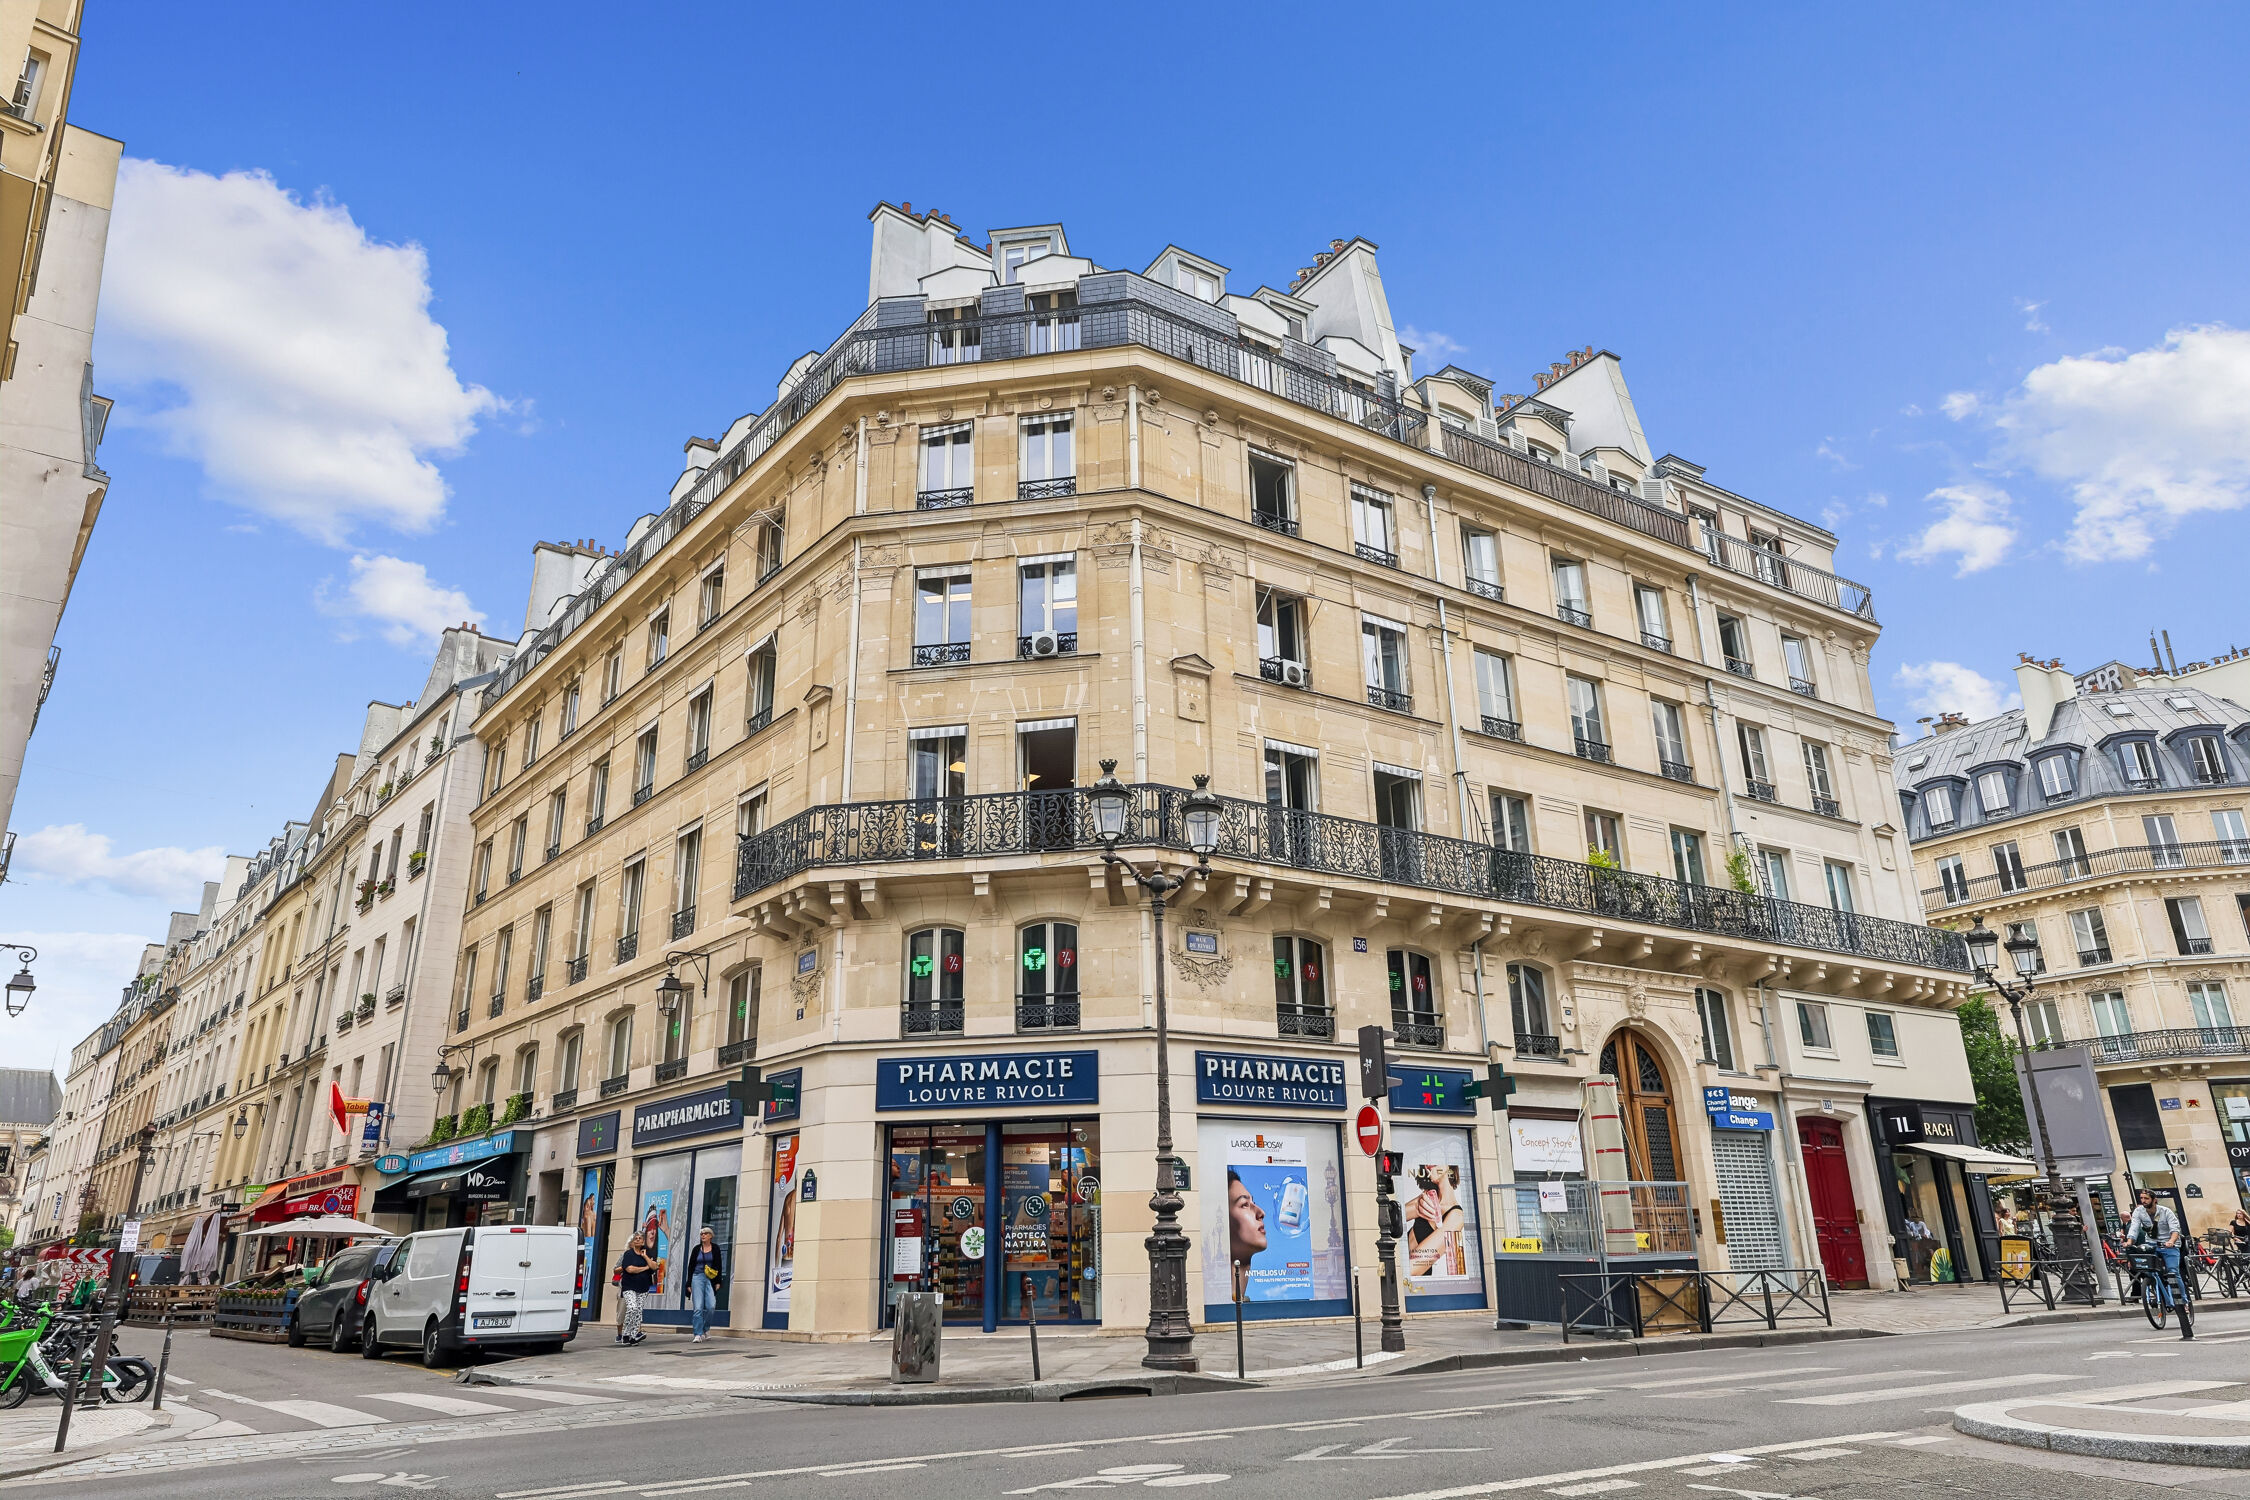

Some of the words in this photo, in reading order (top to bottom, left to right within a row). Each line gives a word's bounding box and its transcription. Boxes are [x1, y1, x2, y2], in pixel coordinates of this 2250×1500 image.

[1353, 939, 1367, 950] 136
[899, 1058, 1073, 1084] PHARMACIE
[1205, 1058, 1343, 1084] PHARMACIE
[908, 1087, 986, 1102] LOUVRE
[996, 1084, 1065, 1099] RIVOLI
[1212, 1084, 1275, 1099] LOUVRE
[1282, 1087, 1334, 1102] RIVOLI
[637, 1098, 731, 1132] PARAPHARMACIE
[1730, 1114, 1758, 1126] Change
[1924, 1122, 1954, 1136] RACH
[1520, 1136, 1550, 1152] Concept
[1552, 1137, 1572, 1148] Store
[2230, 1147, 2250, 1157] OP
[384, 1158, 399, 1170] HD
[1408, 1168, 1443, 1178] NUXE
[1510, 1241, 1532, 1250] Piétons
[34, 1359, 49, 1379] Lime
